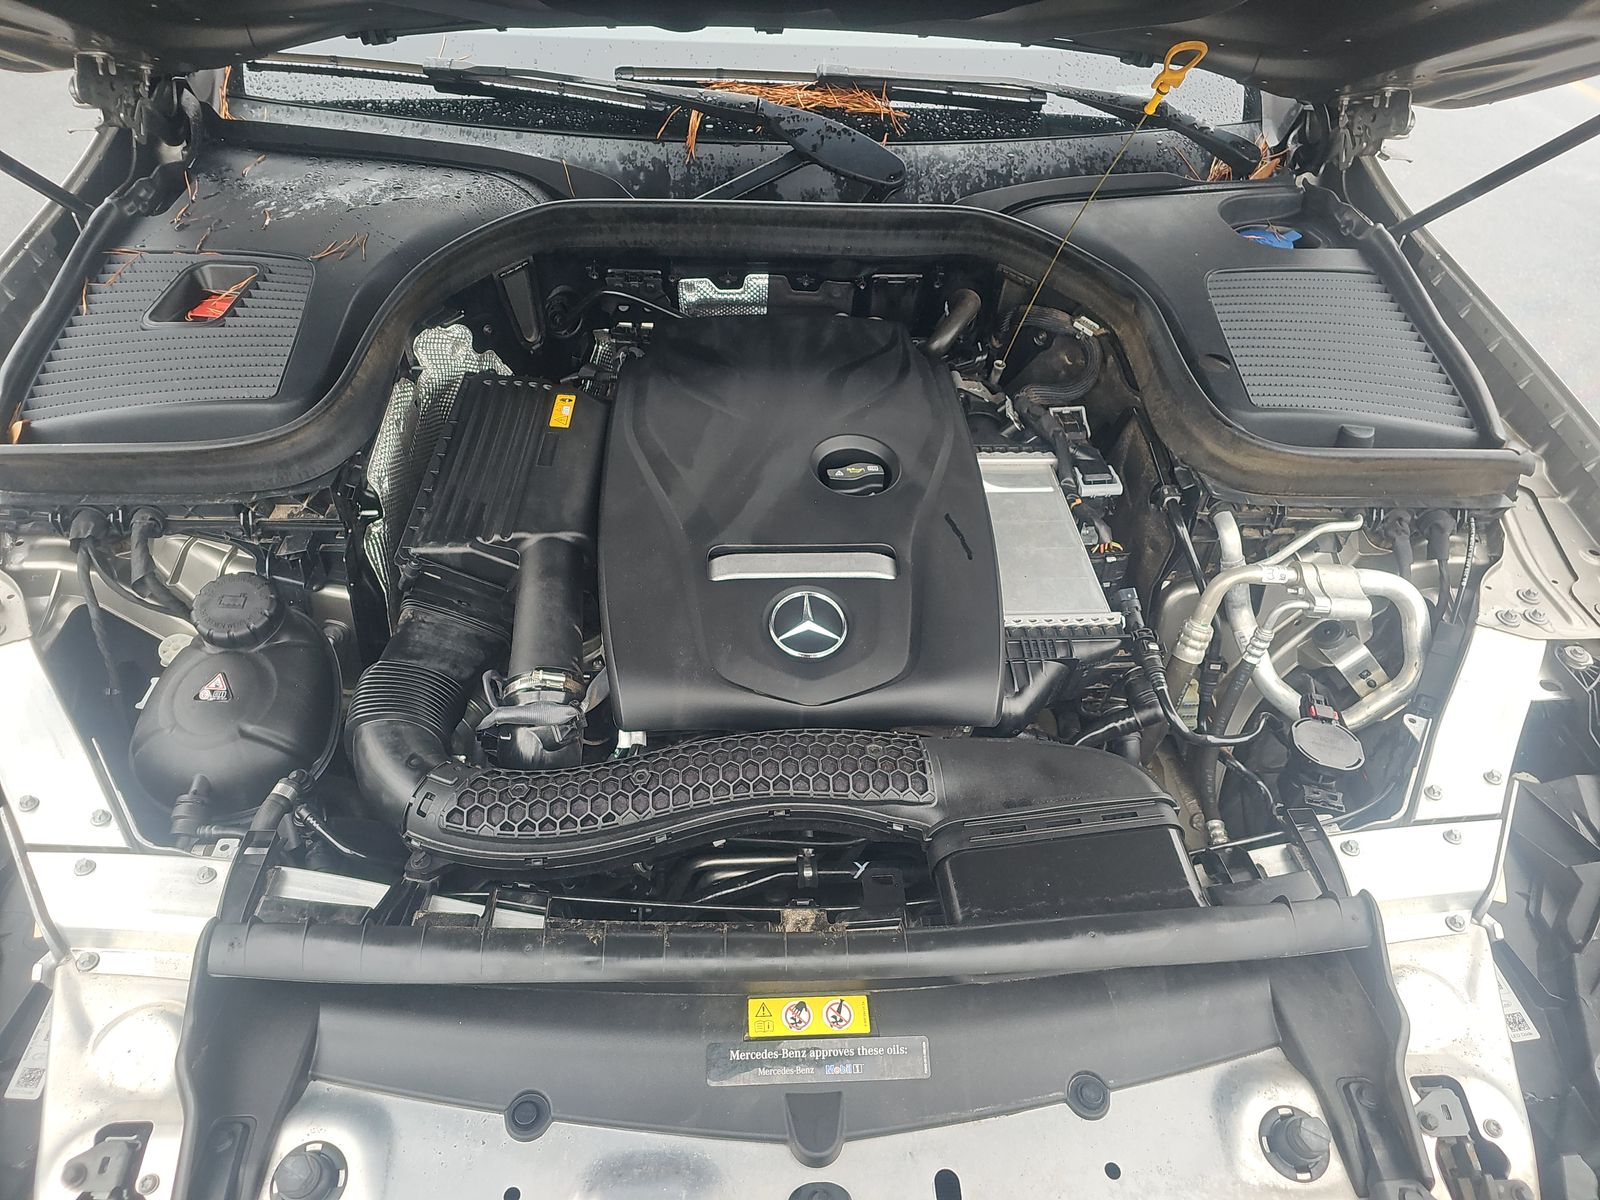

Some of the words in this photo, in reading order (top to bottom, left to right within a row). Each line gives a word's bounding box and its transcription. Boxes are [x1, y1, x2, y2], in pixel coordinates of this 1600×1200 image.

[729, 1048, 807, 1061] Mercedes-Benz
[809, 1047, 855, 1060] approves
[857, 1045, 885, 1056] these
[886, 1044, 908, 1055] oils:
[758, 1066, 815, 1076] Mercedes-Benz
[825, 1064, 852, 1075] Mobil
